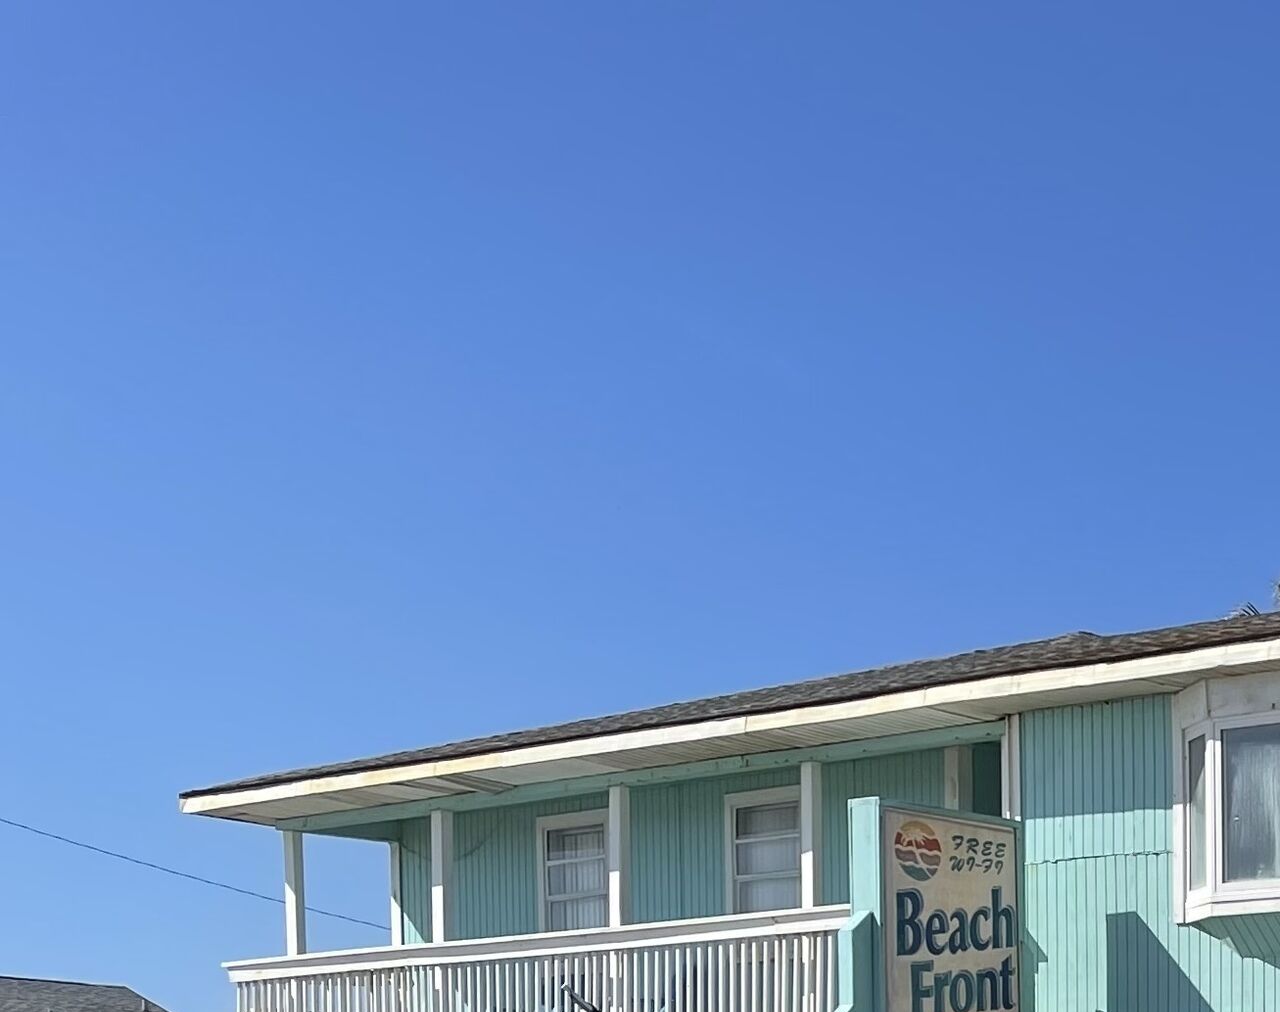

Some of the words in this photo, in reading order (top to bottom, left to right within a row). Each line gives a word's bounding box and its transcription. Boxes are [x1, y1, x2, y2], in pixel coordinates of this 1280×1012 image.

[952, 835, 1006, 858] FREE
[949, 855, 1003, 875] WI-FI
[896, 886, 1016, 956] Beach
